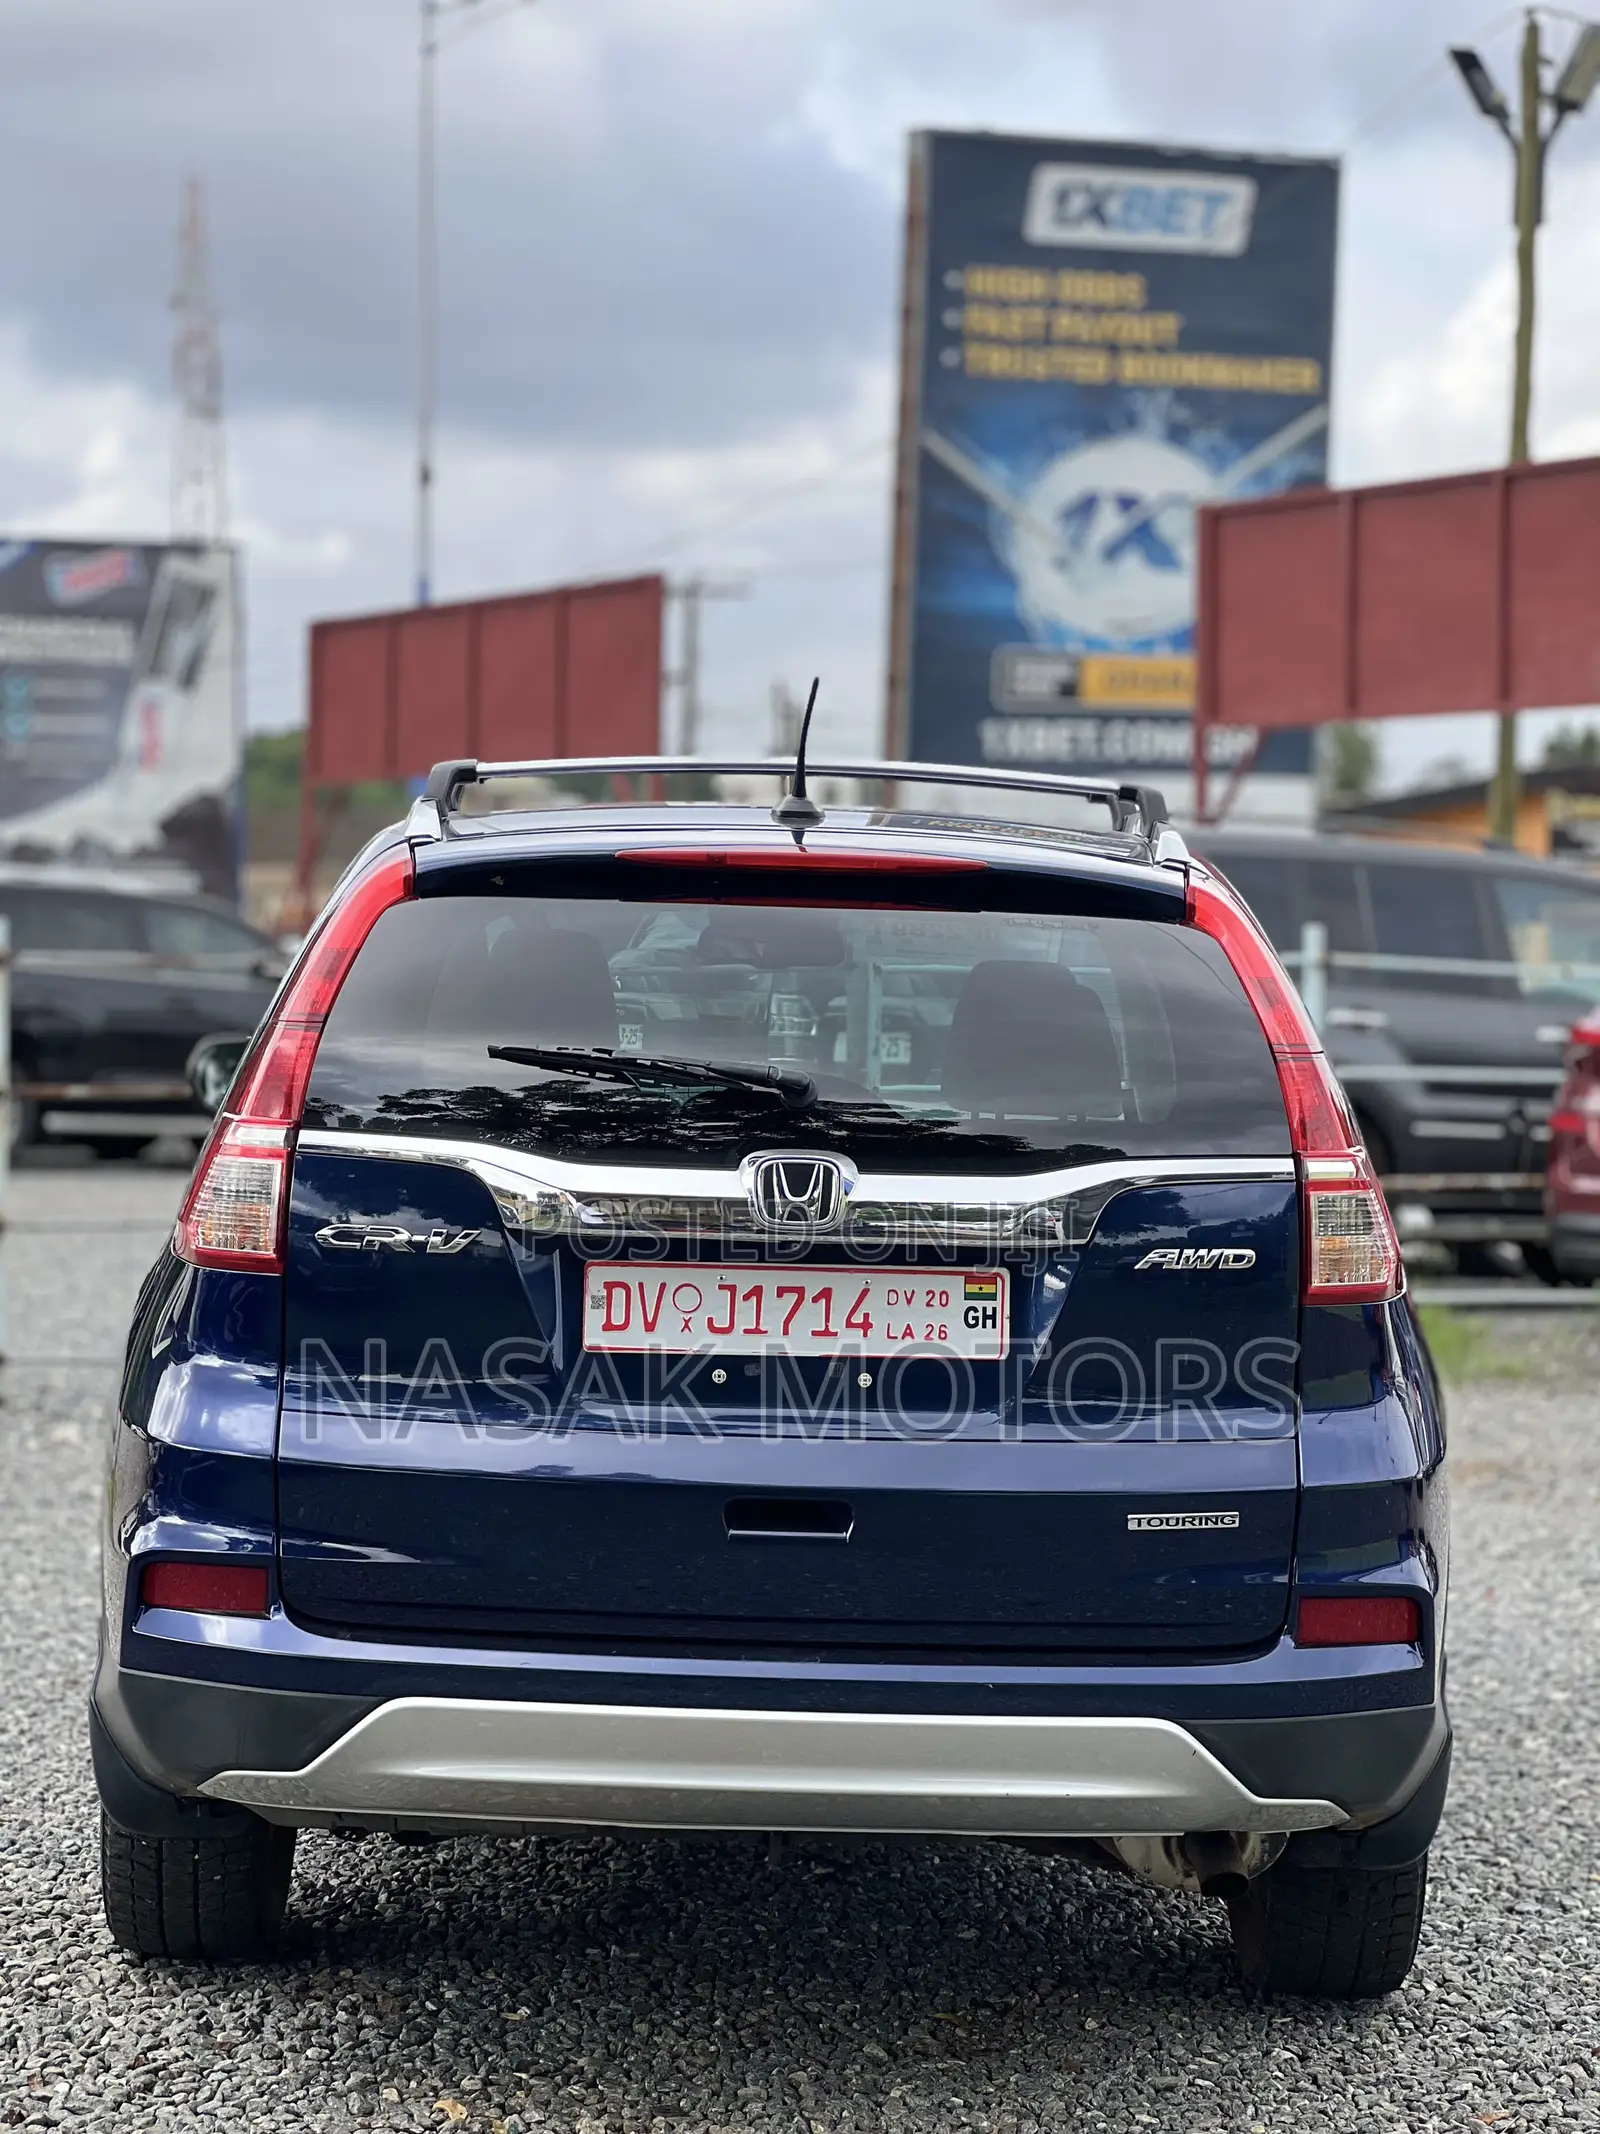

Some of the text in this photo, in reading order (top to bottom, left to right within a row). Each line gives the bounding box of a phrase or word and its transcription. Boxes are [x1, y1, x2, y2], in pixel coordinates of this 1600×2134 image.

[313, 1223, 483, 1254] CR-V
[1133, 1247, 1257, 1270] AWD
[600, 1279, 668, 1334] DV
[705, 1282, 874, 1340] J1714
[885, 1288, 950, 1308] DV 20
[962, 1305, 998, 1330] GH
[885, 1322, 949, 1342] LA 26
[1130, 1513, 1239, 1529] TOURING
